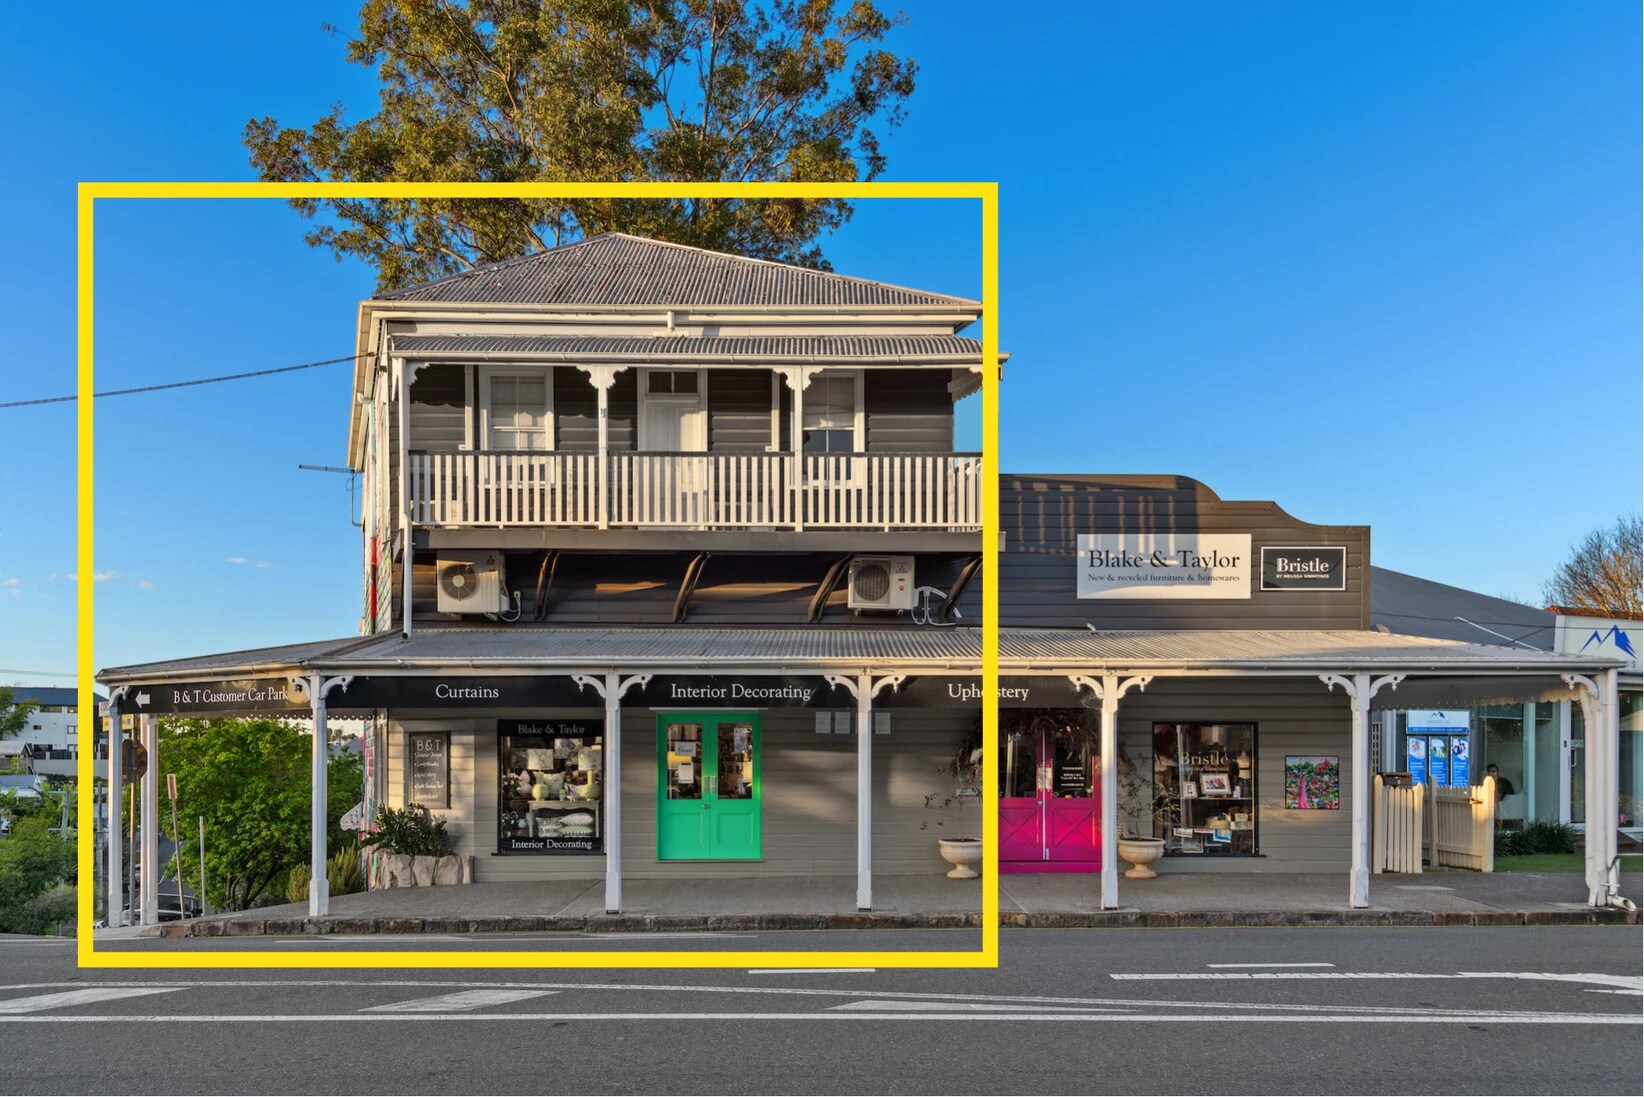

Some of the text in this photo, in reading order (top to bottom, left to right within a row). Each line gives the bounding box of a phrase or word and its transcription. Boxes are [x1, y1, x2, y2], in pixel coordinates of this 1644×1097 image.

[1088, 549, 1240, 572] Blake & Taylor
[1276, 556, 1329, 572] Bristle
[1087, 573, 1240, 583] New & recycled furniture & homewares
[174, 685, 289, 704] B & T Customer Car Park
[435, 683, 499, 698] Curtains
[671, 683, 811, 701] Interior Decorating
[948, 683, 1029, 701] Uphstery
[518, 724, 586, 736] Blake & Taylor
[1182, 751, 1230, 766] Bristle
[512, 839, 592, 851] Interior Decorating
